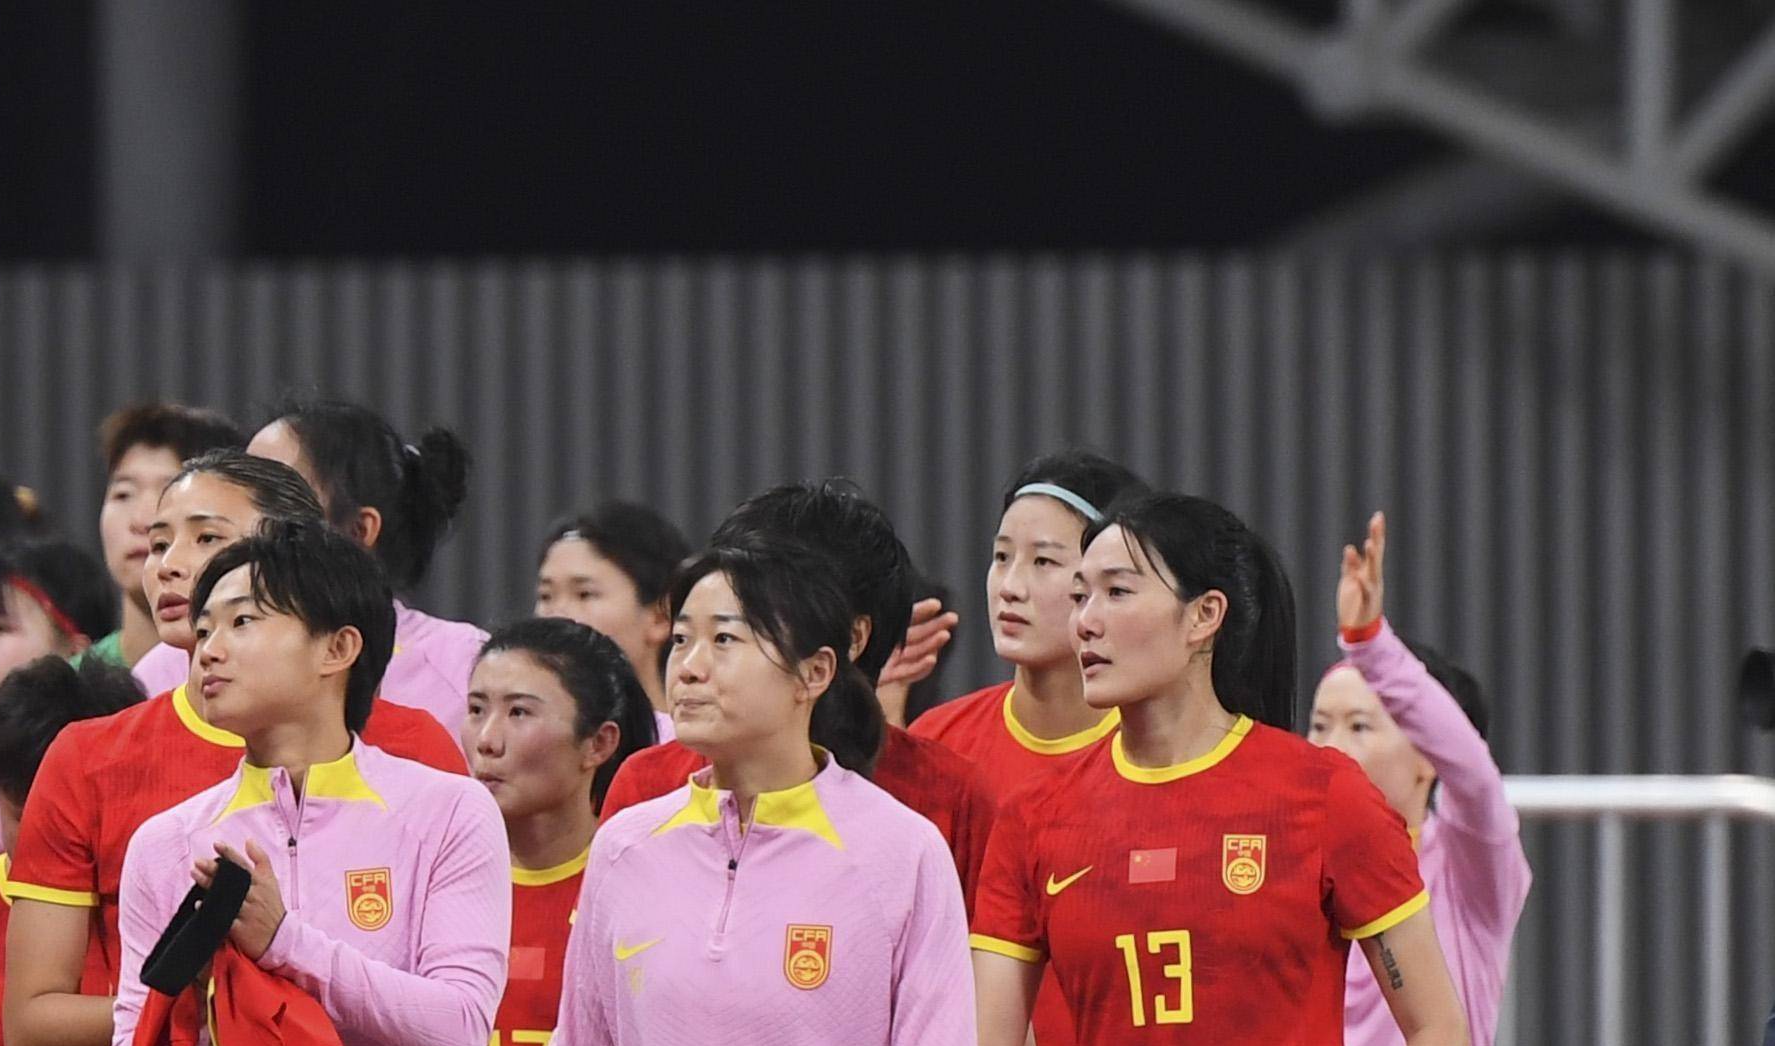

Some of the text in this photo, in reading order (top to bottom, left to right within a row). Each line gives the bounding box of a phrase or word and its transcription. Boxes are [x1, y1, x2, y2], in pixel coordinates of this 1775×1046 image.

[1227, 839, 1262, 851] CFA
[351, 874, 386, 887] CFA
[792, 929, 827, 942] CFA
[1115, 929, 1194, 1027] 13
